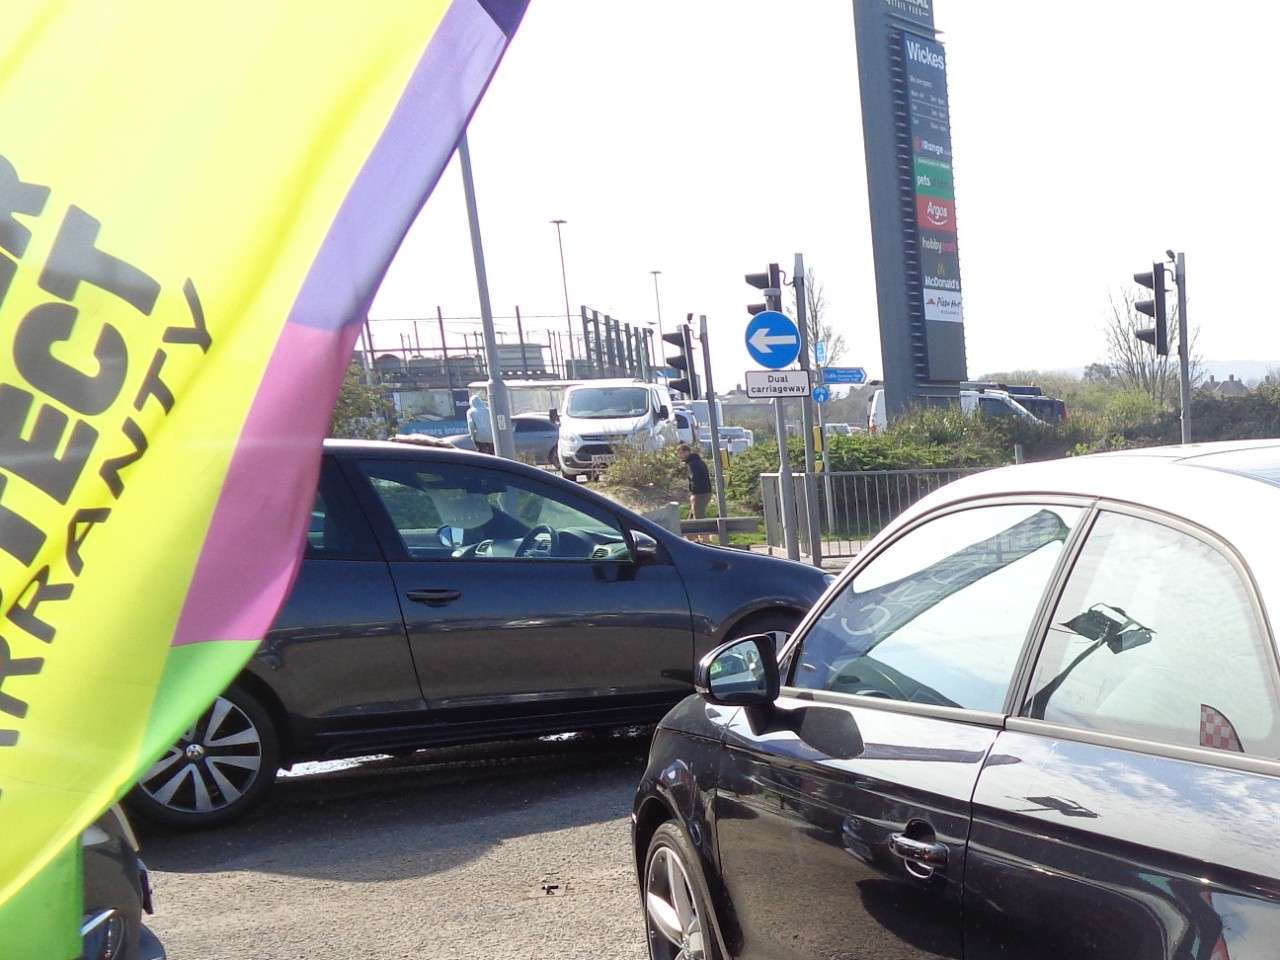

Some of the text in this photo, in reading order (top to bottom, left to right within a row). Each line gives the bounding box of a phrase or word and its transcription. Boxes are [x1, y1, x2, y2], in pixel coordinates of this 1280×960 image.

[906, 40, 945, 70] Wickes
[927, 201, 948, 219] Argos
[925, 275, 960, 289] McDonald's
[767, 375, 789, 383] Dual
[751, 385, 806, 394] carriageway
